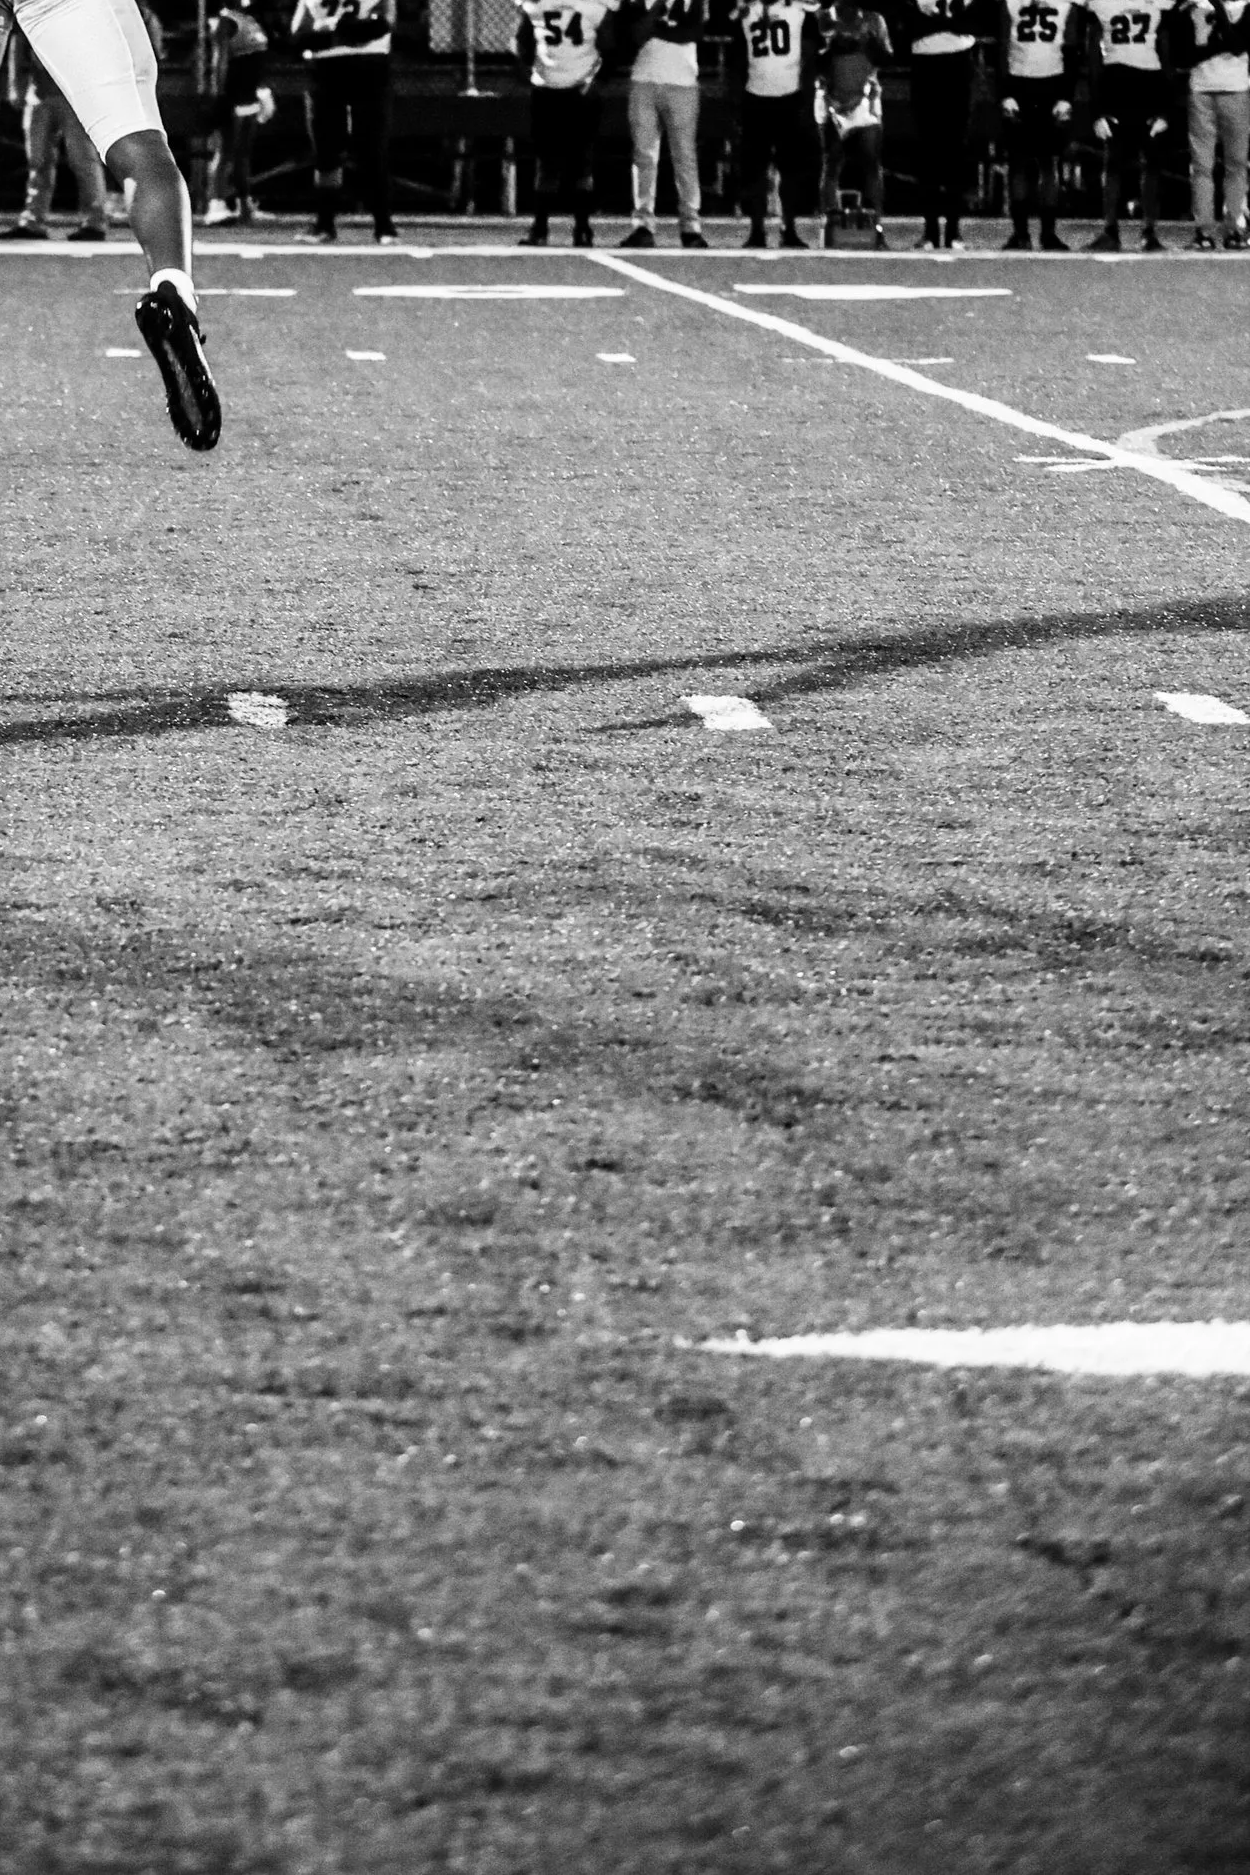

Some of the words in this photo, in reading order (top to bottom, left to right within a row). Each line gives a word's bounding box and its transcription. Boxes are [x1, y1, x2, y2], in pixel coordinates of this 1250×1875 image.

[543, 11, 583, 45] 54
[751, 20, 790, 57] 20
[1017, 6, 1058, 42] 25
[1110, 13, 1150, 44] 27
